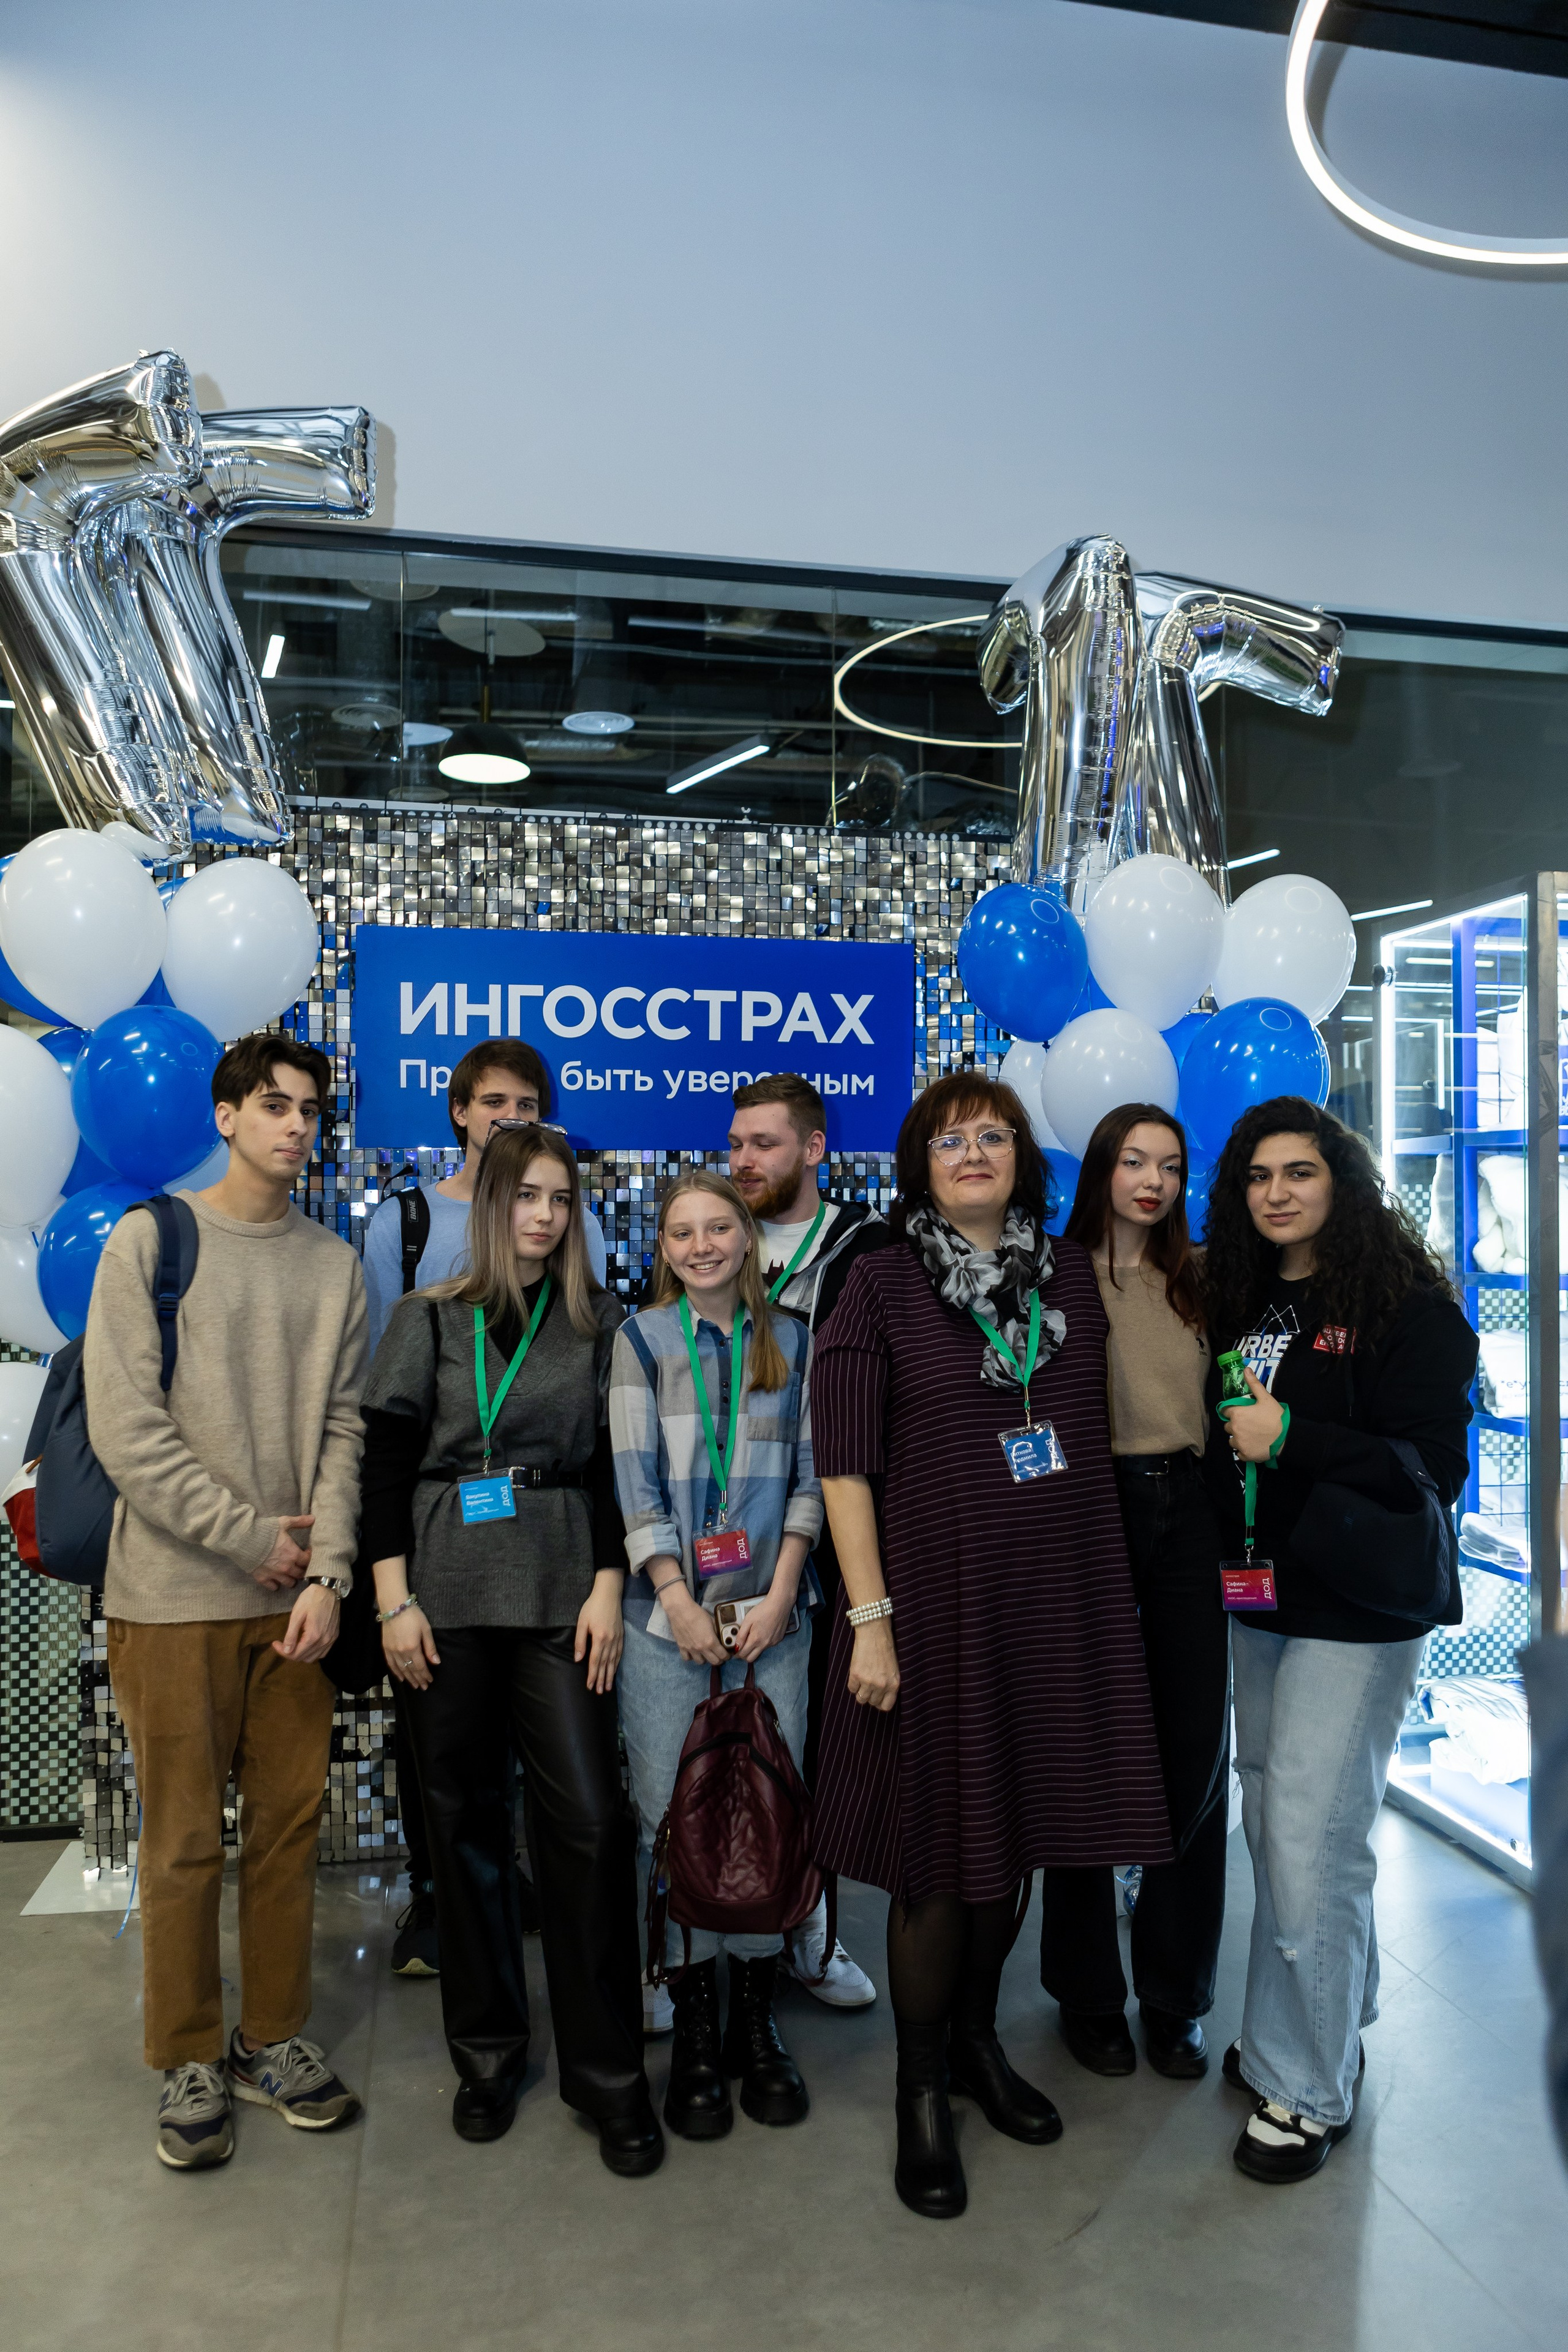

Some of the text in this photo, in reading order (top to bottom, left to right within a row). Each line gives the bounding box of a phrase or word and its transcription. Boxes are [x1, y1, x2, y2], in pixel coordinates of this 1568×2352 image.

[400, 982, 875, 1045] ИНГОССТРАХ
[561, 1060, 875, 1099] быть уверным
[409, 1200, 417, 1220] BONE
[500, 1485, 511, 1506] ДОД
[737, 1537, 748, 1559] ДОД
[1262, 1577, 1272, 1599] ДОД
